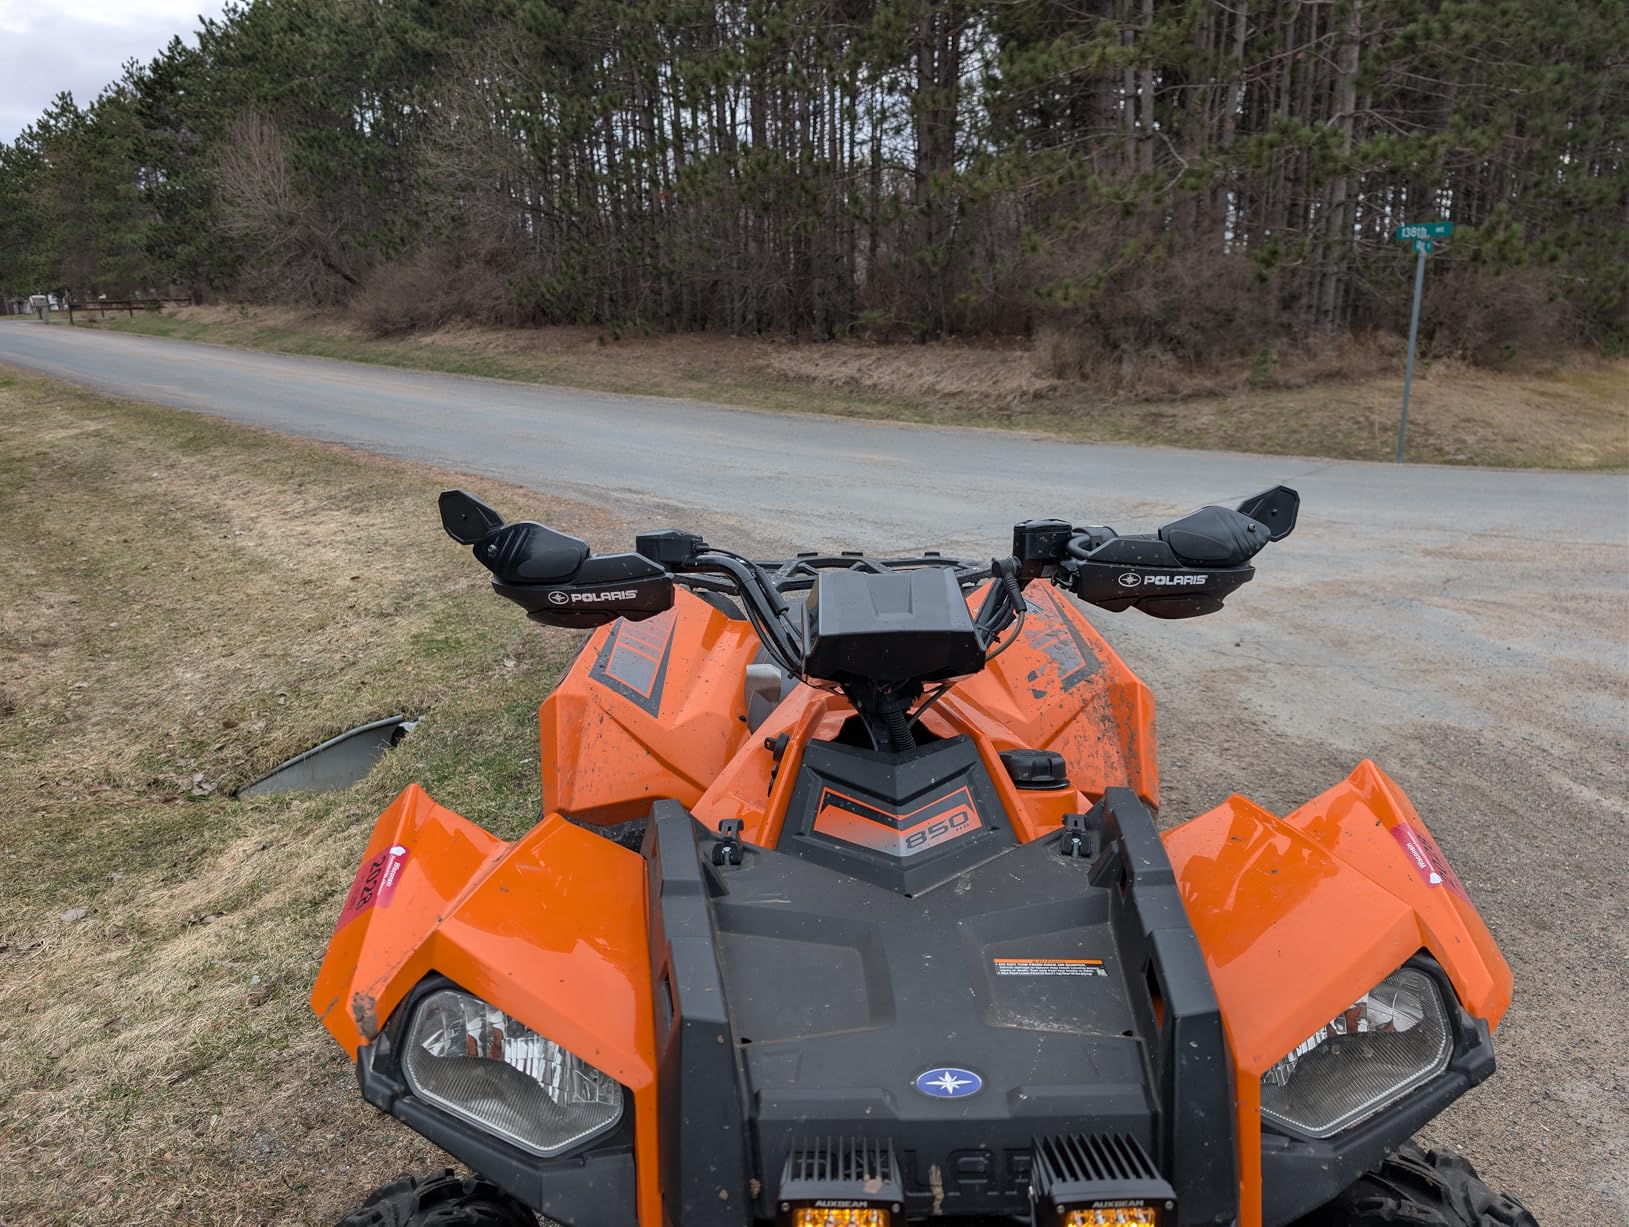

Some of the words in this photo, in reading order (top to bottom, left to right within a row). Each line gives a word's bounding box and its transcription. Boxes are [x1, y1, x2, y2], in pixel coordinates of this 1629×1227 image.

[1144, 575, 1208, 586] POLARIS
[570, 589, 638, 603] POLARIS
[905, 811, 969, 849] 850
[1407, 842, 1426, 869] Wisconsin
[356, 855, 387, 910] 2028
[386, 861, 401, 888] Wisconsin
[815, 1200, 868, 1208] AUXBEAM
[1092, 1200, 1144, 1209] AUXBEAM
